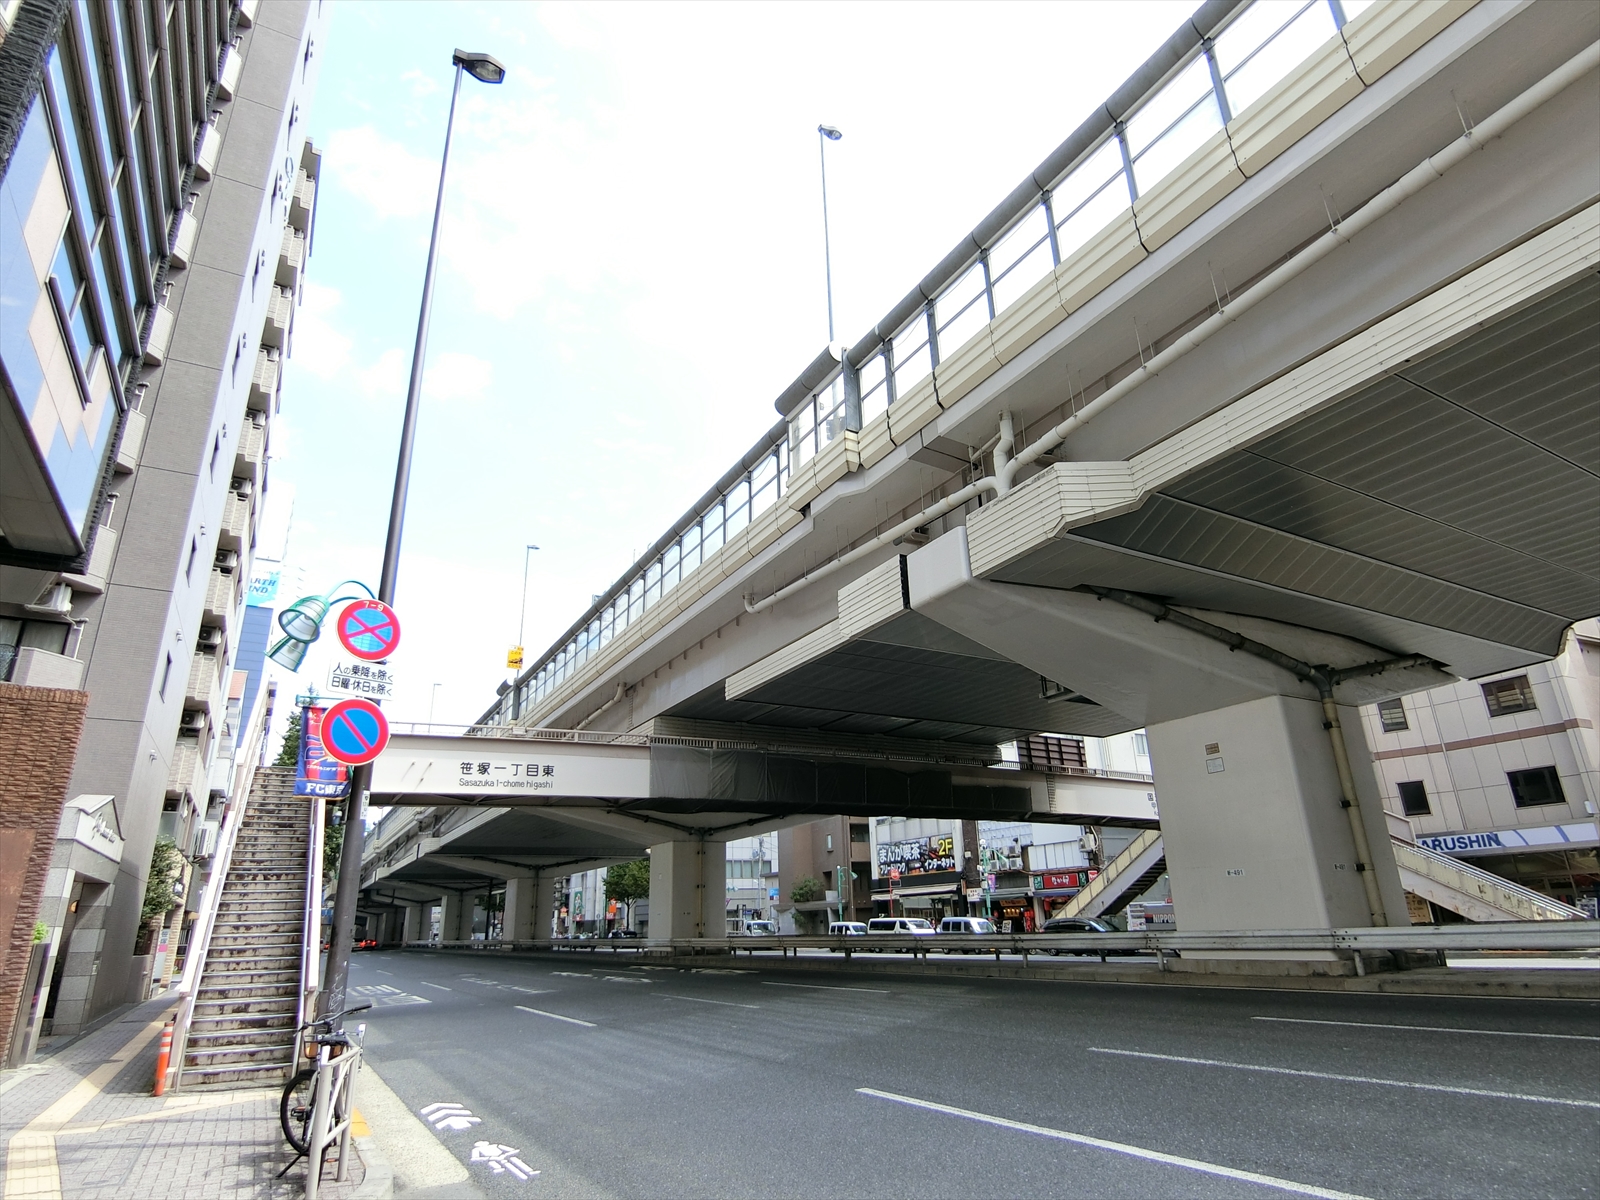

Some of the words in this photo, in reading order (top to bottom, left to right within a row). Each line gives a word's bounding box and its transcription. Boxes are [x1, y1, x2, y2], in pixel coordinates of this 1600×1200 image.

[332, 661, 394, 683] 人の乗降を除く
[460, 761, 555, 777] 笹塚一丁目東
[305, 782, 346, 795] FC東京
[459, 777, 495, 788] Sasazuka
[526, 780, 554, 791] higashi
[879, 842, 921, 863] まんが喫茶
[938, 838, 953, 856] 2F
[924, 856, 955, 870] インターネット
